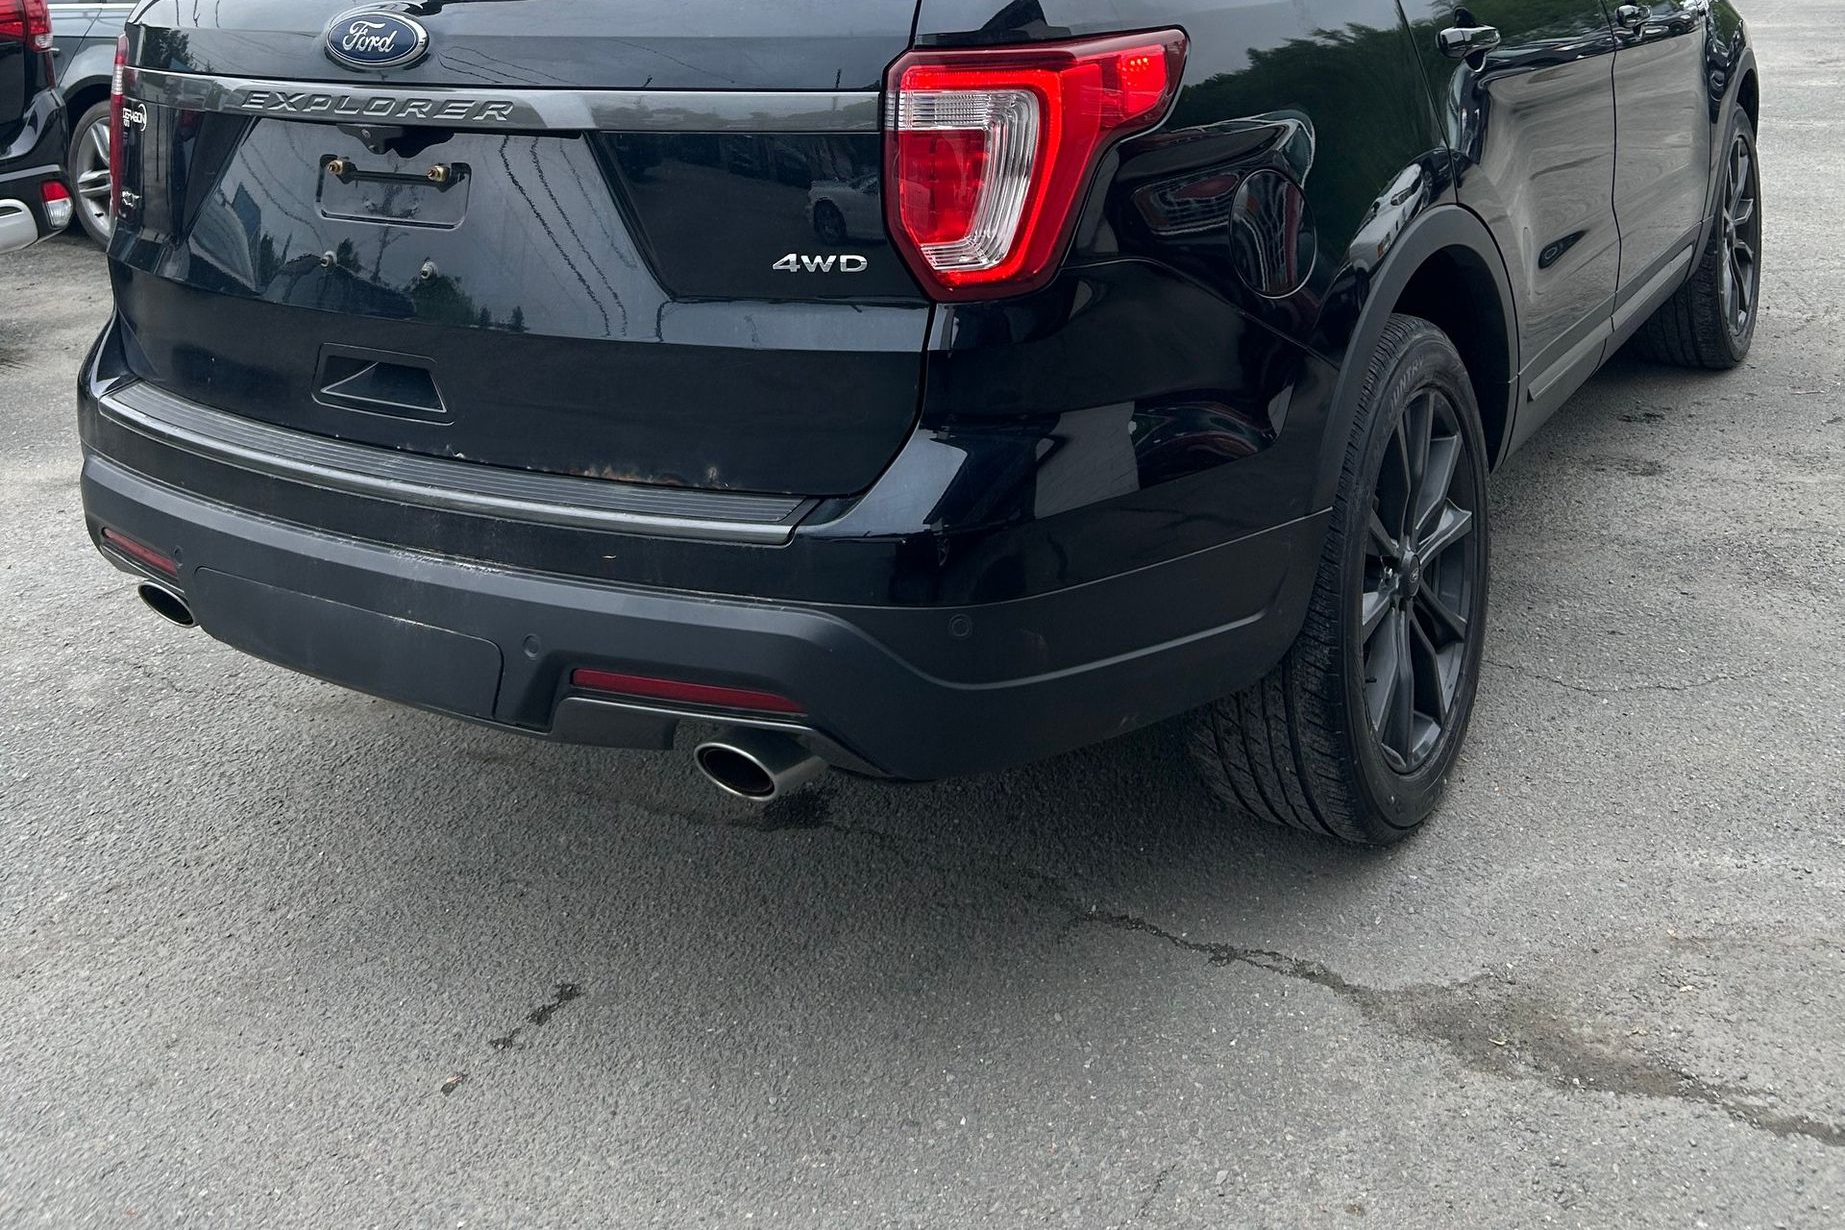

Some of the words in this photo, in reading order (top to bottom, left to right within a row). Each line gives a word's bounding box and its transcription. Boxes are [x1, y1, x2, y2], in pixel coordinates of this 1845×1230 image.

[342, 20, 398, 53] Ford
[241, 90, 514, 121] EXPLORER
[772, 253, 868, 273] 4WD
